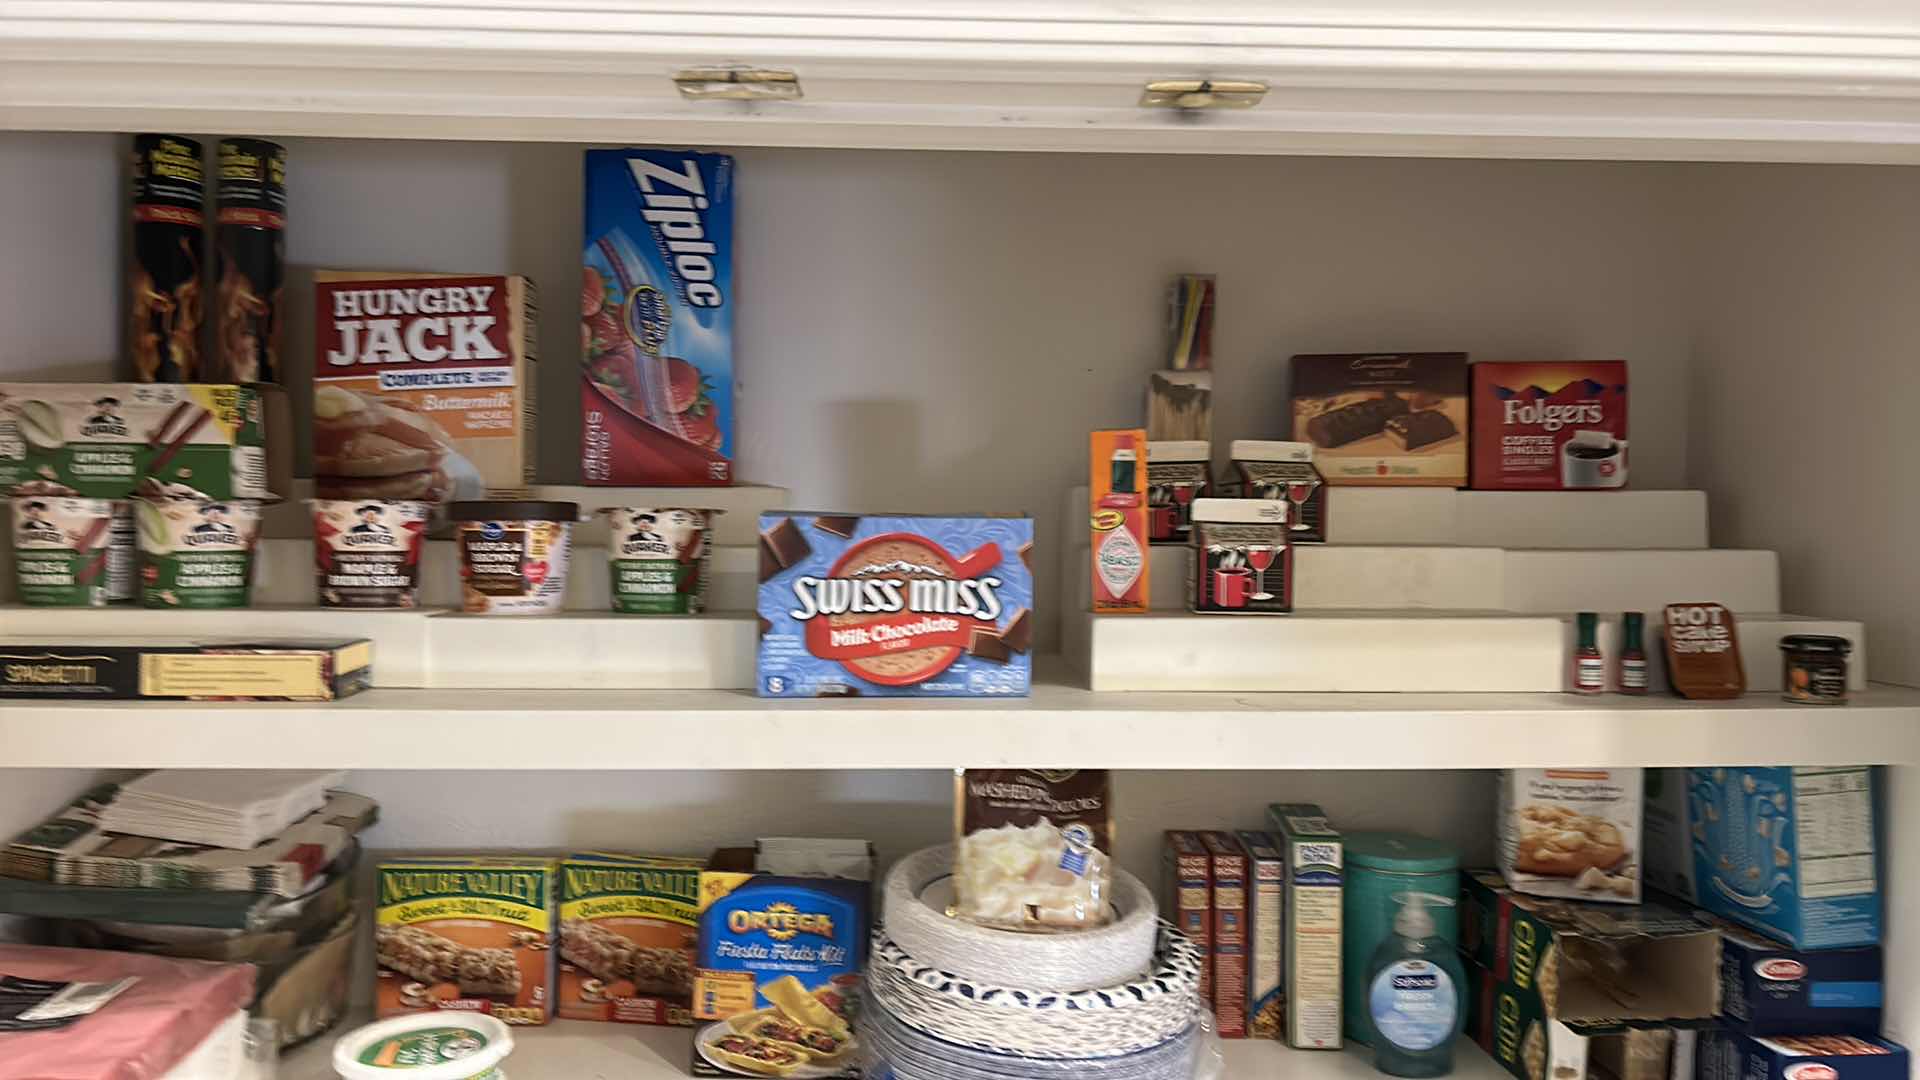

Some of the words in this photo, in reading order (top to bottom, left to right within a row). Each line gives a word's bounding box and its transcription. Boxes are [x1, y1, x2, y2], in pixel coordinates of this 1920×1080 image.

[625, 158, 723, 308] Ziploc
[332, 286, 495, 317] HUNGRY
[328, 316, 507, 365] JACK
[383, 371, 475, 387] COMPLETE
[1503, 398, 1604, 432] Folgers
[343, 533, 396, 546] QUAKER
[790, 576, 905, 620] SWISS
[1668, 606, 1724, 625] HOT
[831, 627, 869, 647] Milk
[869, 617, 960, 644] Chocolate
[383, 872, 464, 903] NATURE
[465, 872, 541, 904] VALLEY
[562, 868, 640, 899] NATURE
[641, 869, 698, 900] VALLE
[728, 909, 834, 938] ORTEGA
[717, 940, 769, 960] Fiesta
[771, 943, 816, 961] Flats
